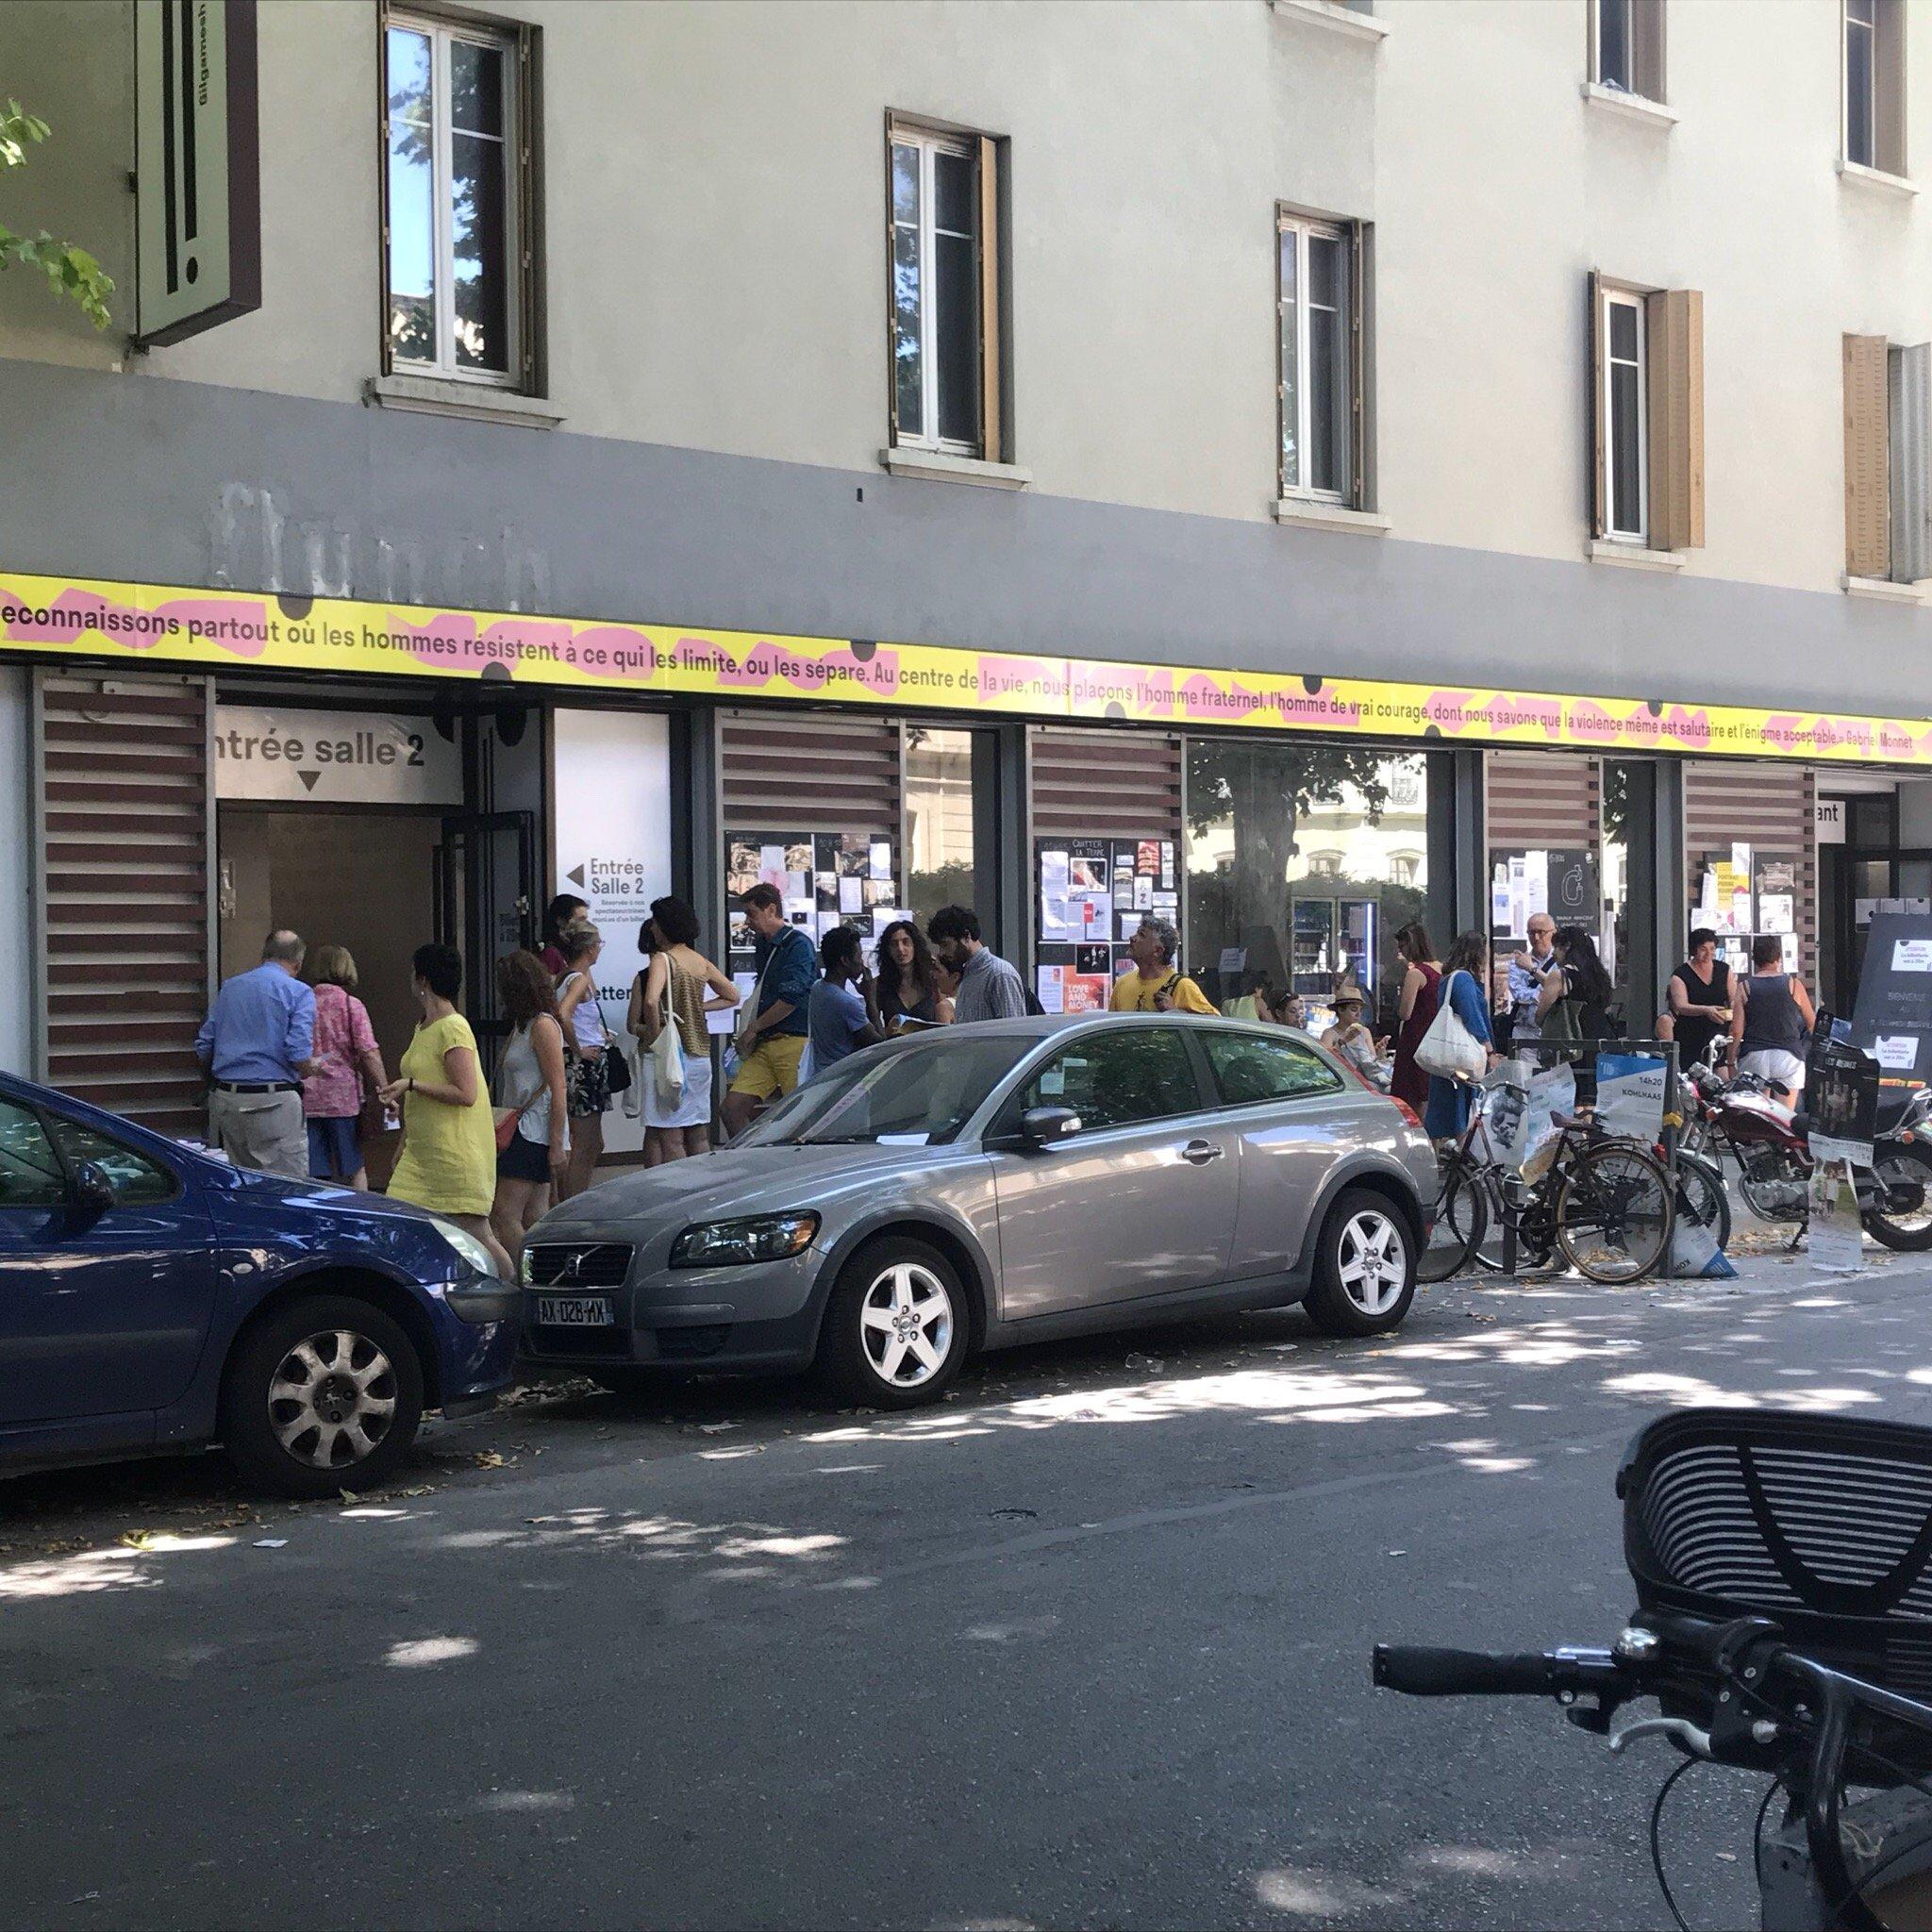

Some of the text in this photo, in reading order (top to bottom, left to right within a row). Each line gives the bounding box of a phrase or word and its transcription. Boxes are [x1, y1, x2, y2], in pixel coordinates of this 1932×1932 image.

[199, 4, 208, 106] Gilgamesh
[2, 605, 179, 635] econnaissons
[189, 618, 280, 644] partout
[287, 620, 315, 644] où
[323, 622, 355, 646] les
[363, 625, 457, 655] hommes
[464, 633, 559, 662] résistent
[565, 641, 577, 663] à
[583, 648, 607, 665] ce
[613, 644, 643, 673] qui
[651, 647, 677, 669] les
[683, 648, 741, 676] limite,
[746, 658, 768, 675] ou
[774, 655, 800, 677] les
[806, 658, 870, 689] sépare.
[874, 661, 893, 684] Au
[899, 667, 954, 688] centre
[958, 669, 978, 690] de
[984, 670, 997, 691] la
[1001, 672, 1028, 695] vie,
[1032, 679, 1070, 696] nous
[1074, 679, 1132, 705] plaçons
[1137, 682, 1198, 705] l'homme
[1202, 686, 1267, 712] fraternel,
[1270, 691, 1327, 713] l'homme
[1330, 698, 1346, 714] de
[1349, 699, 1374, 716] vrai
[1377, 703, 1431, 724] courage,
[1434, 703, 1462, 722] dont
[1465, 708, 1493, 724] nous
[1497, 710, 1537, 725] savons
[1541, 713, 1560, 732] que
[1564, 709, 1574, 727] la
[1577, 713, 1623, 732] violence
[1625, 717, 1658, 734] même
[1661, 720, 1677, 735] est
[1680, 718, 1724, 739] salutaire
[1728, 724, 1738, 739] et
[1740, 723, 1781, 744] l'énigme
[1846, 729, 1878, 747] Gabriel
[1880, 733, 1913, 749] Monnet
[315, 732, 396, 765] salle
[407, 734, 425, 766] 2
[591, 858, 644, 874] Entrée
[591, 877, 643, 894] Salle 2
[1622, 1089, 1662, 1101] KOHLKAAS
